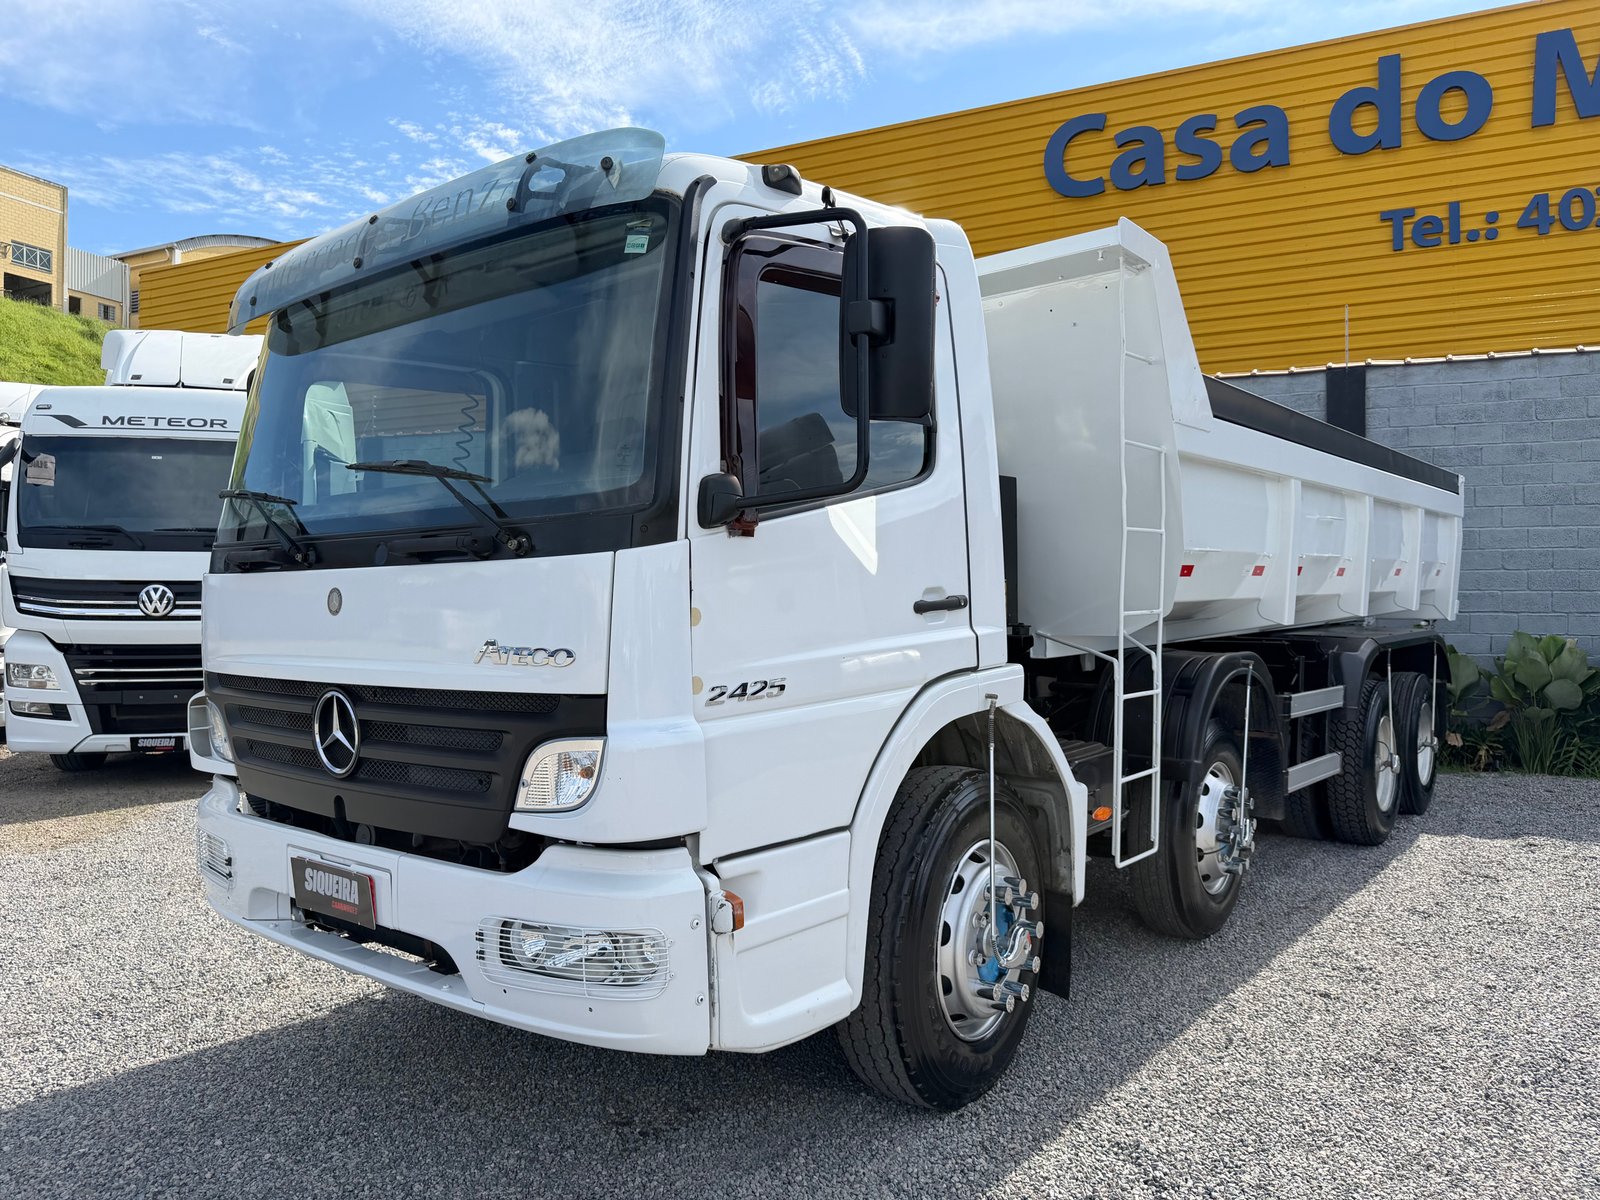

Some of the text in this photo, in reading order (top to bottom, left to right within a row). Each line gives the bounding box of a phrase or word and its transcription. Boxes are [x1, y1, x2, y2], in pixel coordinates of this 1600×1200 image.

[1044, 104, 1291, 198] Casa
[1328, 53, 1493, 155] do
[1380, 187, 1600, 252] Tel.: 40
[101, 415, 228, 428] METEOR
[704, 677, 787, 707] 2425
[137, 738, 176, 747] SIQUEIRA
[304, 867, 359, 905] SIQUEIRA
